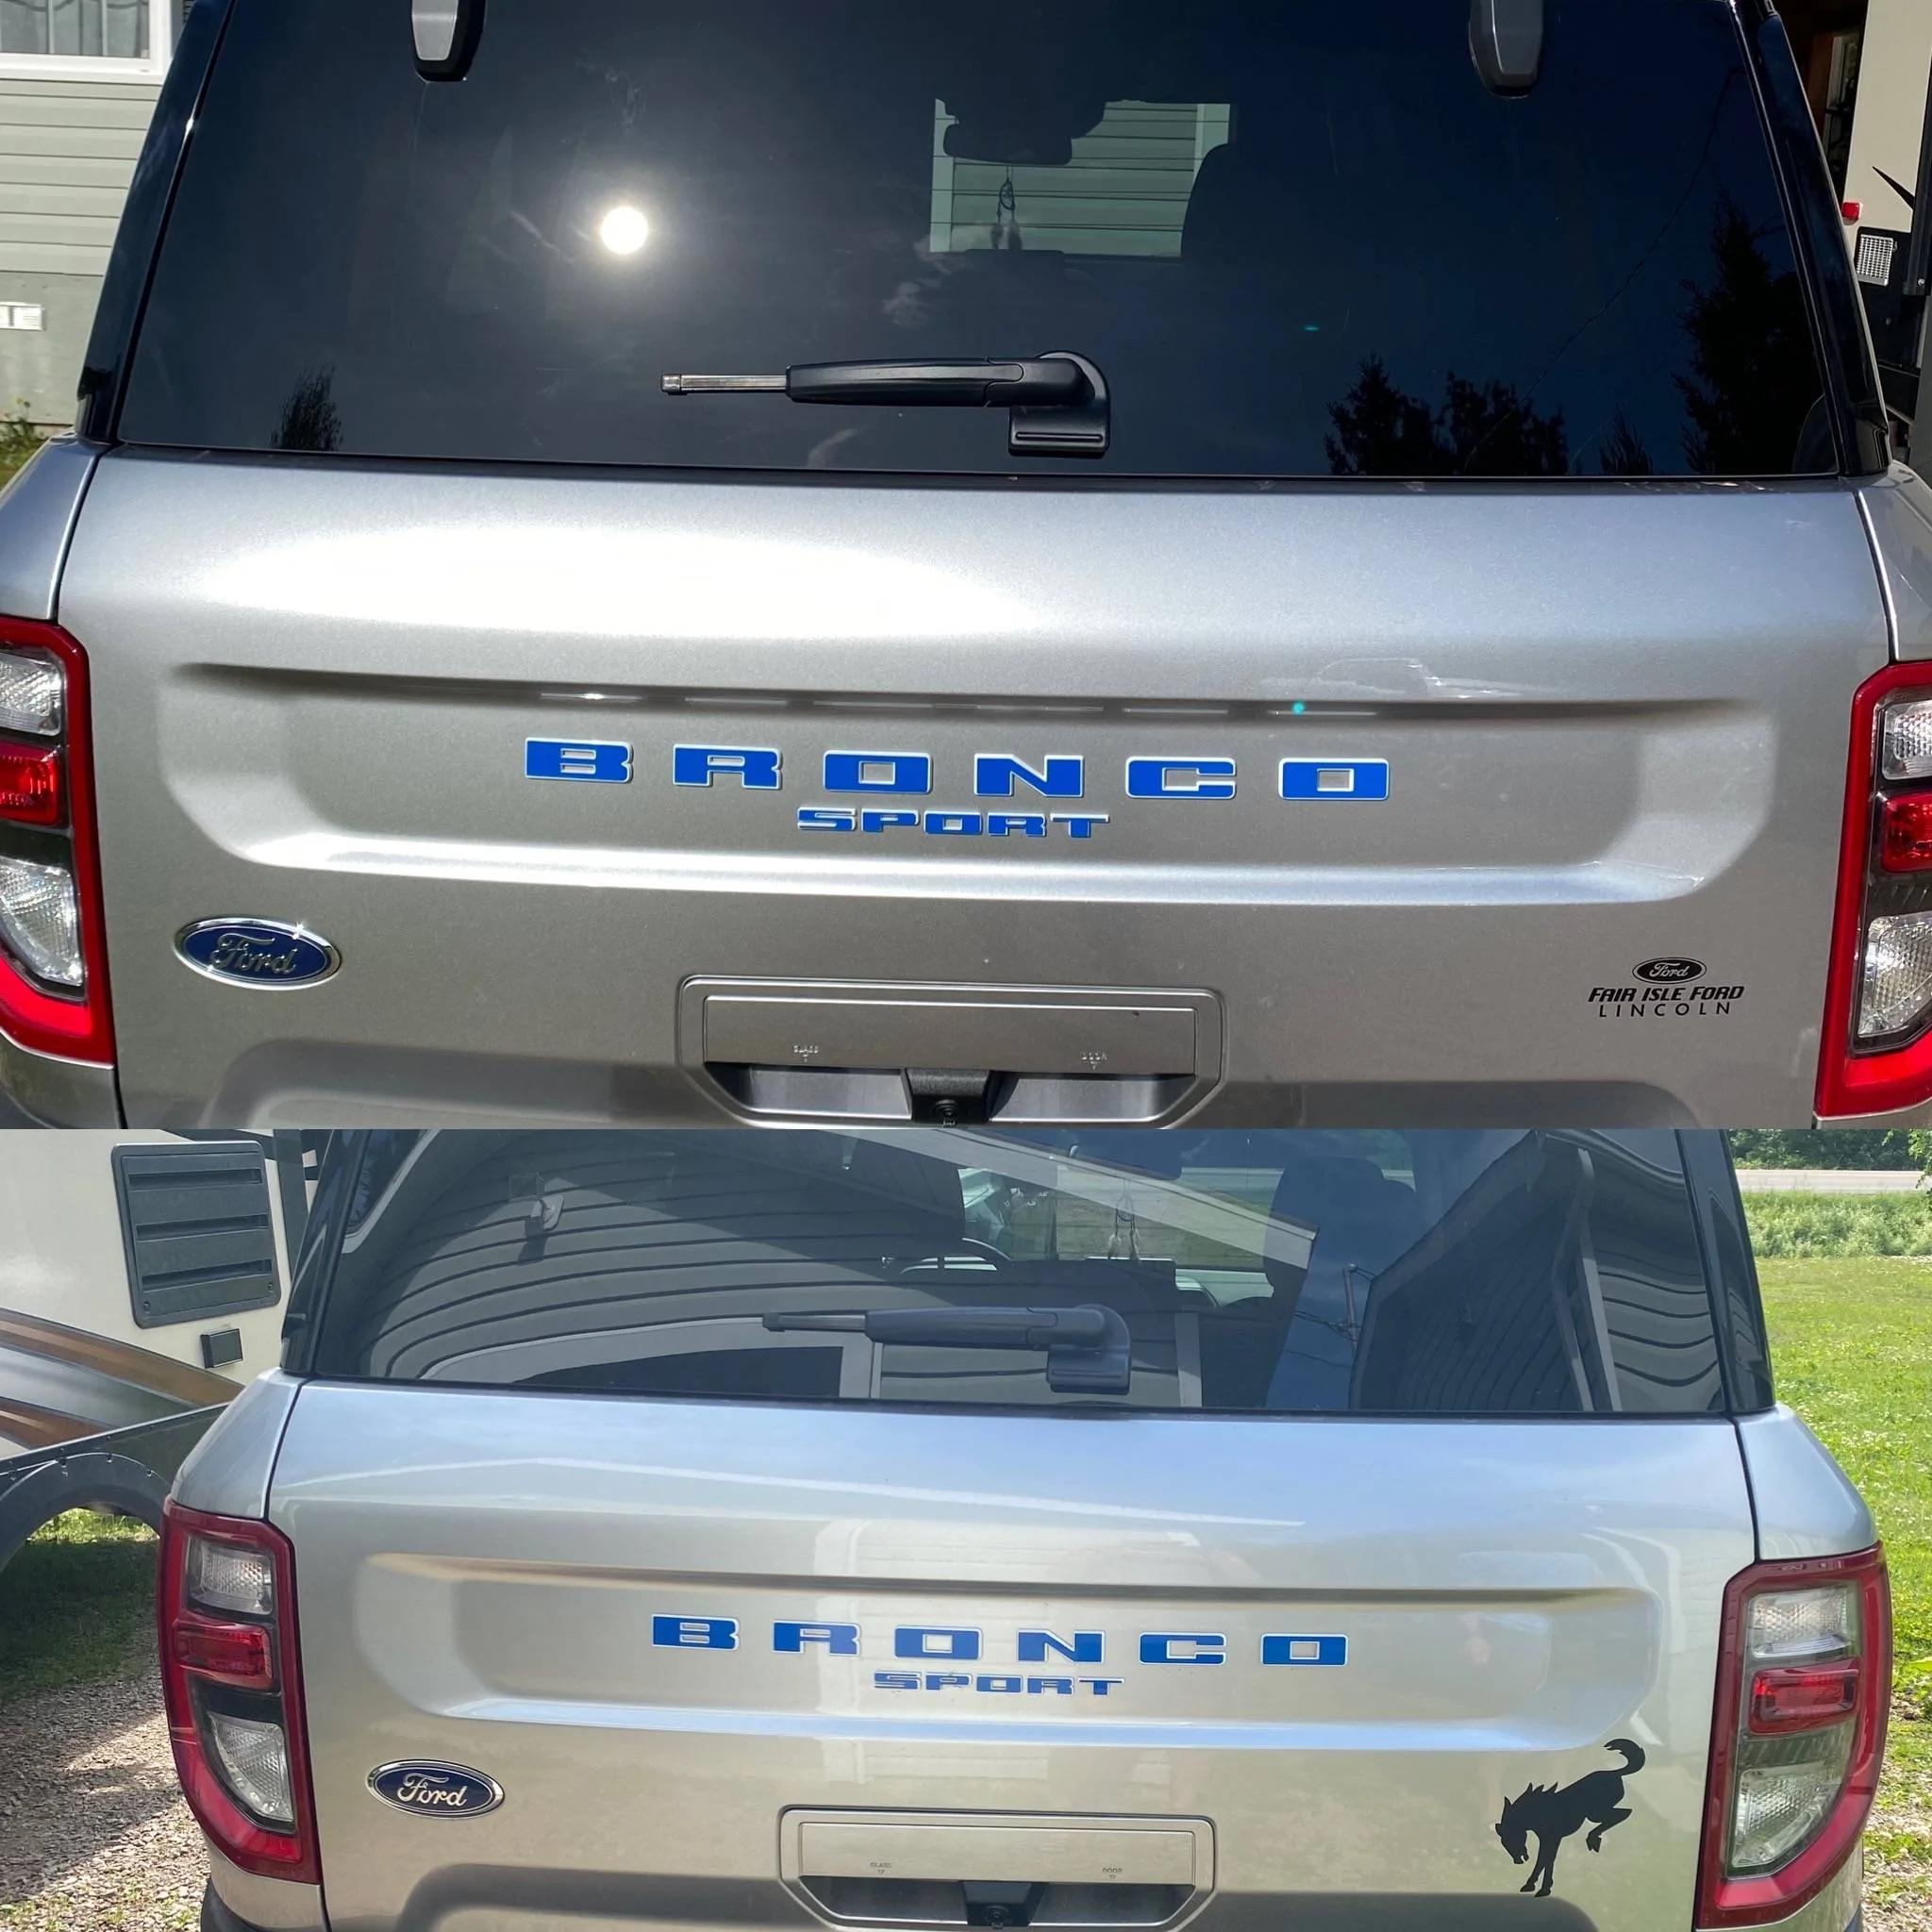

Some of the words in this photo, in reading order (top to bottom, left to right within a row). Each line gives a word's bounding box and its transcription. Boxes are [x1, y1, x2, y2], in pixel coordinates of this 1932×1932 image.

[525, 736, 1391, 802] BRONCO
[796, 806, 1110, 839] SPORT
[208, 932, 299, 975] Ford
[1648, 961, 1690, 977] Ford
[1588, 987, 1637, 1003] FAIR
[1641, 987, 1686, 1002] ISLE
[1689, 986, 1745, 1001] FORD
[1599, 1001, 1731, 1018] LINCOLN
[651, 1613, 1349, 1668] BRONCO
[873, 1669, 1125, 1696] SPORT
[396, 1772, 469, 1807] Ford
